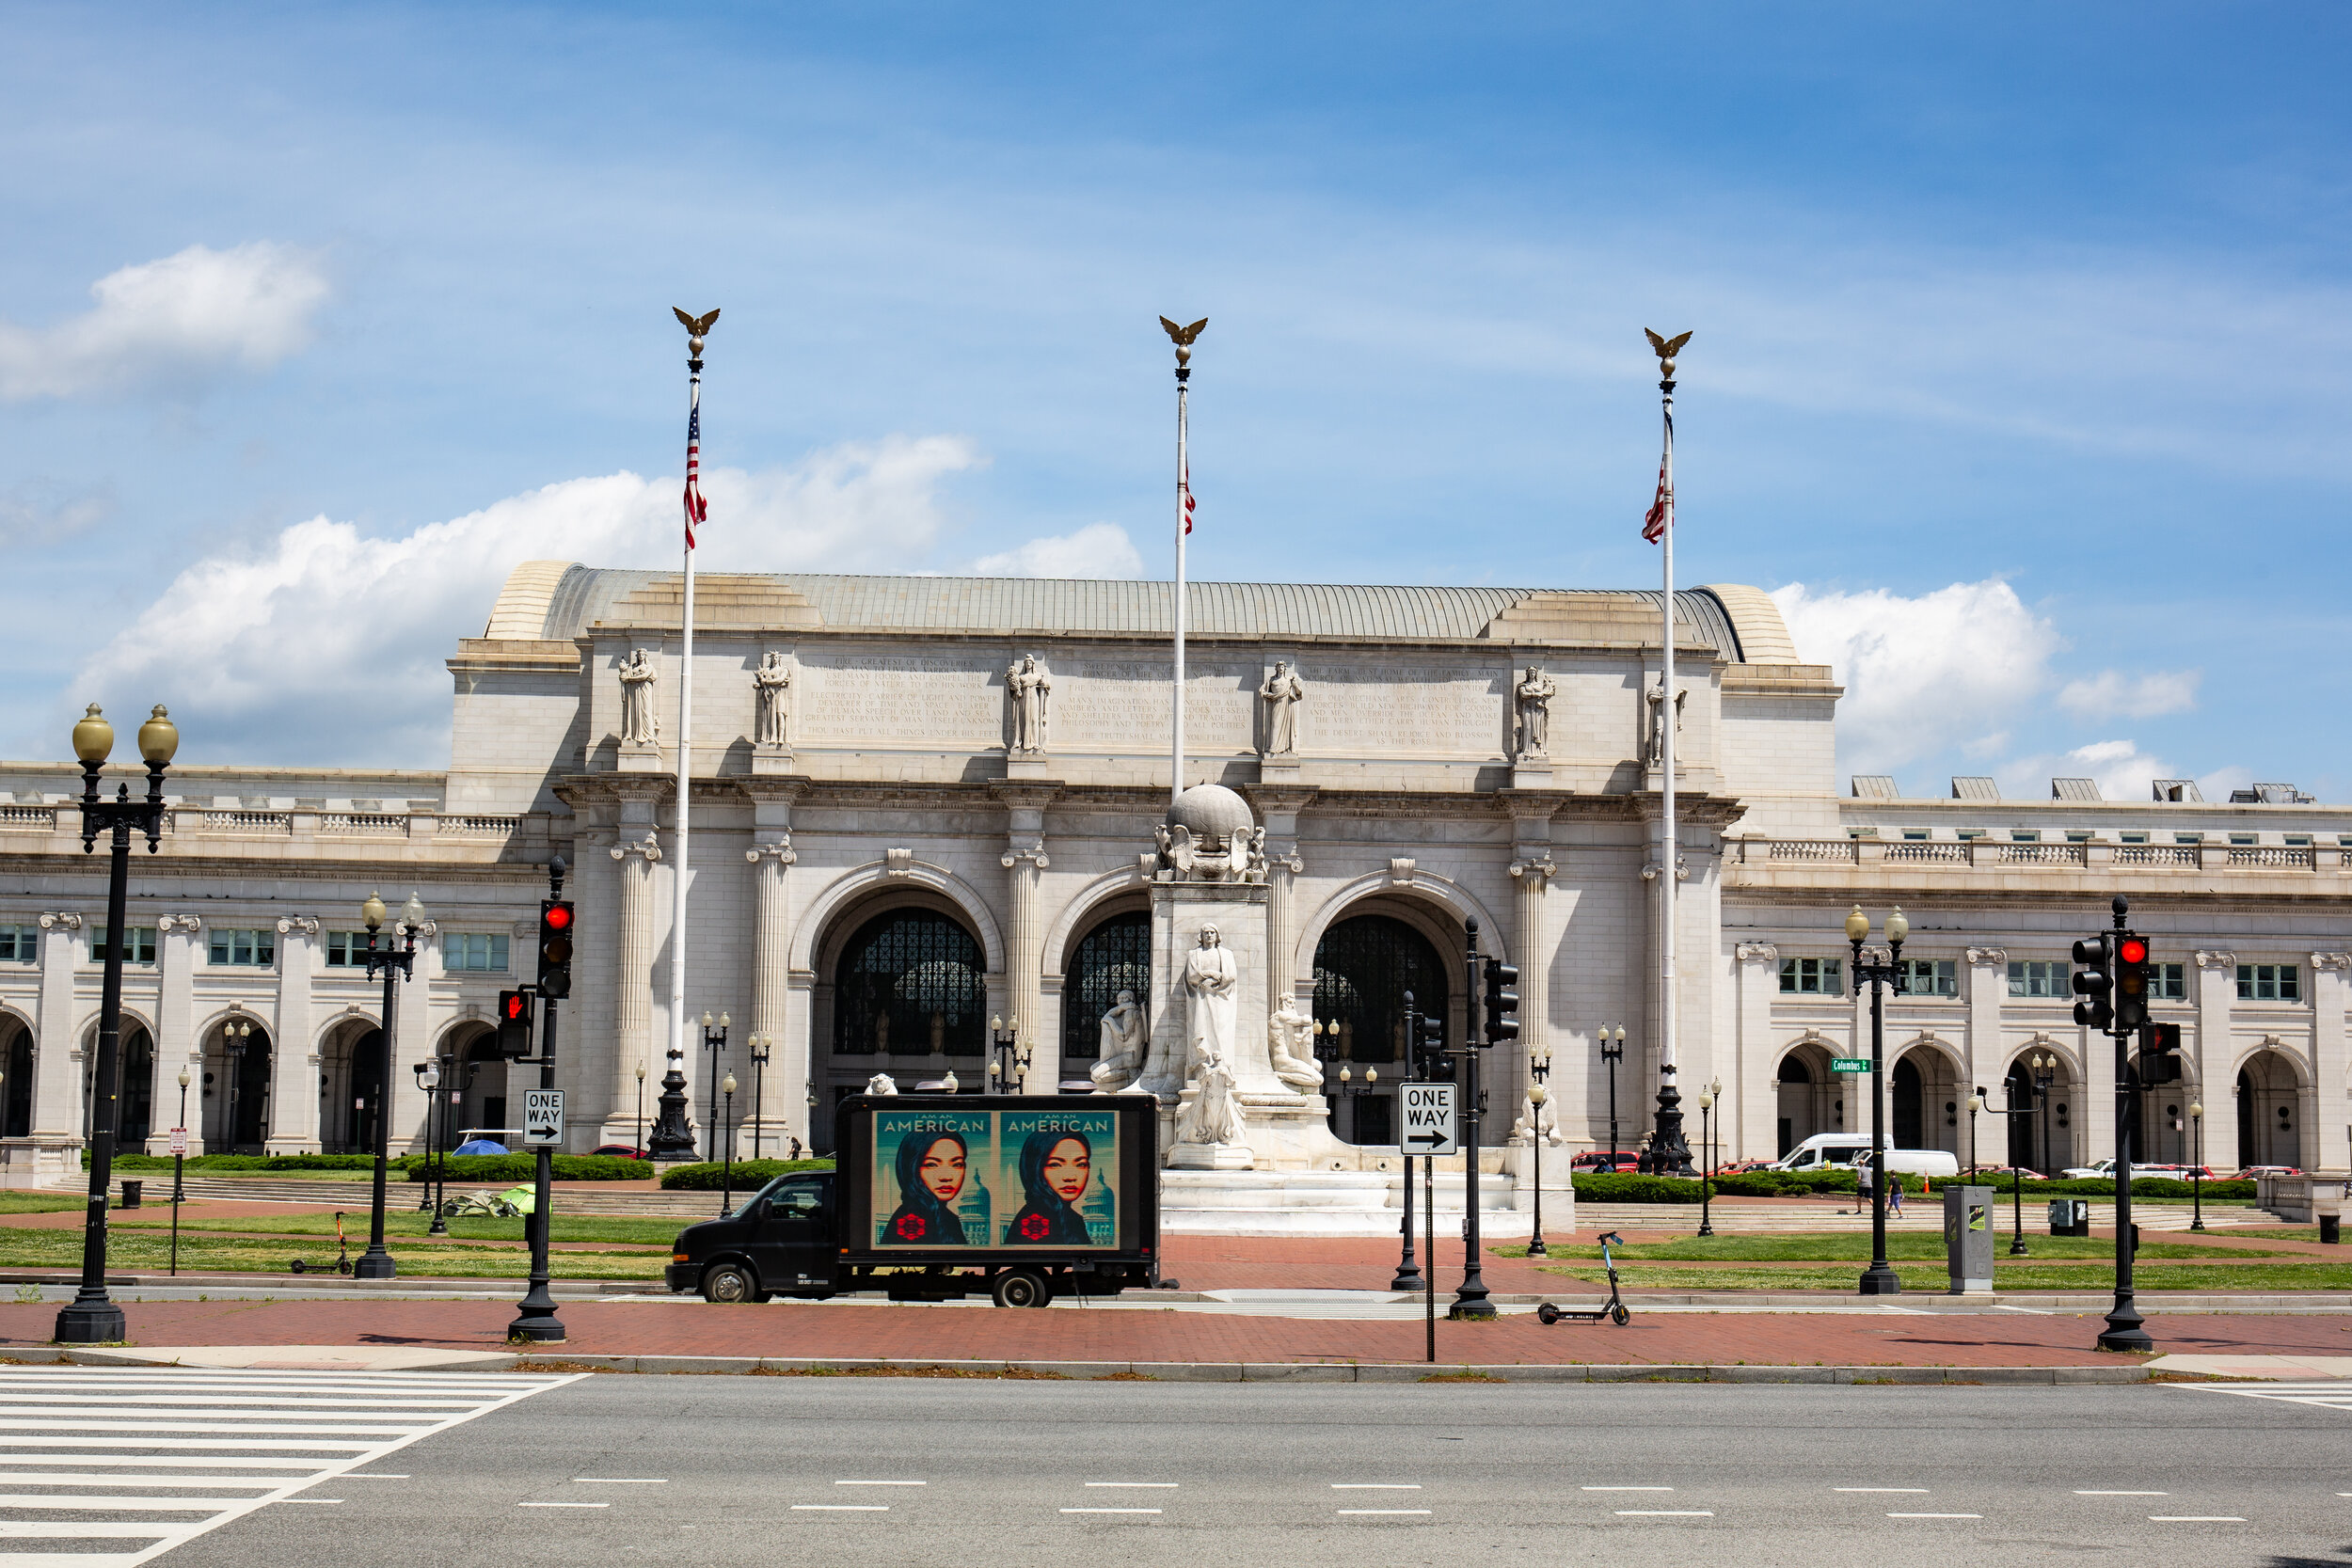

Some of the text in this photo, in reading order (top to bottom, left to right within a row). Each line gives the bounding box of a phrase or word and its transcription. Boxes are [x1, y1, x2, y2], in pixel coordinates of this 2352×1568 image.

[921, 658, 973, 667] DISCOVERIES
[810, 691, 861, 699] ELECTRICITY
[1834, 1060, 1860, 1070] Columbus
[530, 1095, 559, 1107] ONE
[1408, 1090, 1449, 1106] ONE
[529, 1110, 559, 1122] WAY
[1408, 1110, 1449, 1126] WAY
[884, 1120, 985, 1132] AMERICAN
[1008, 1120, 1108, 1132] AMERICAN
